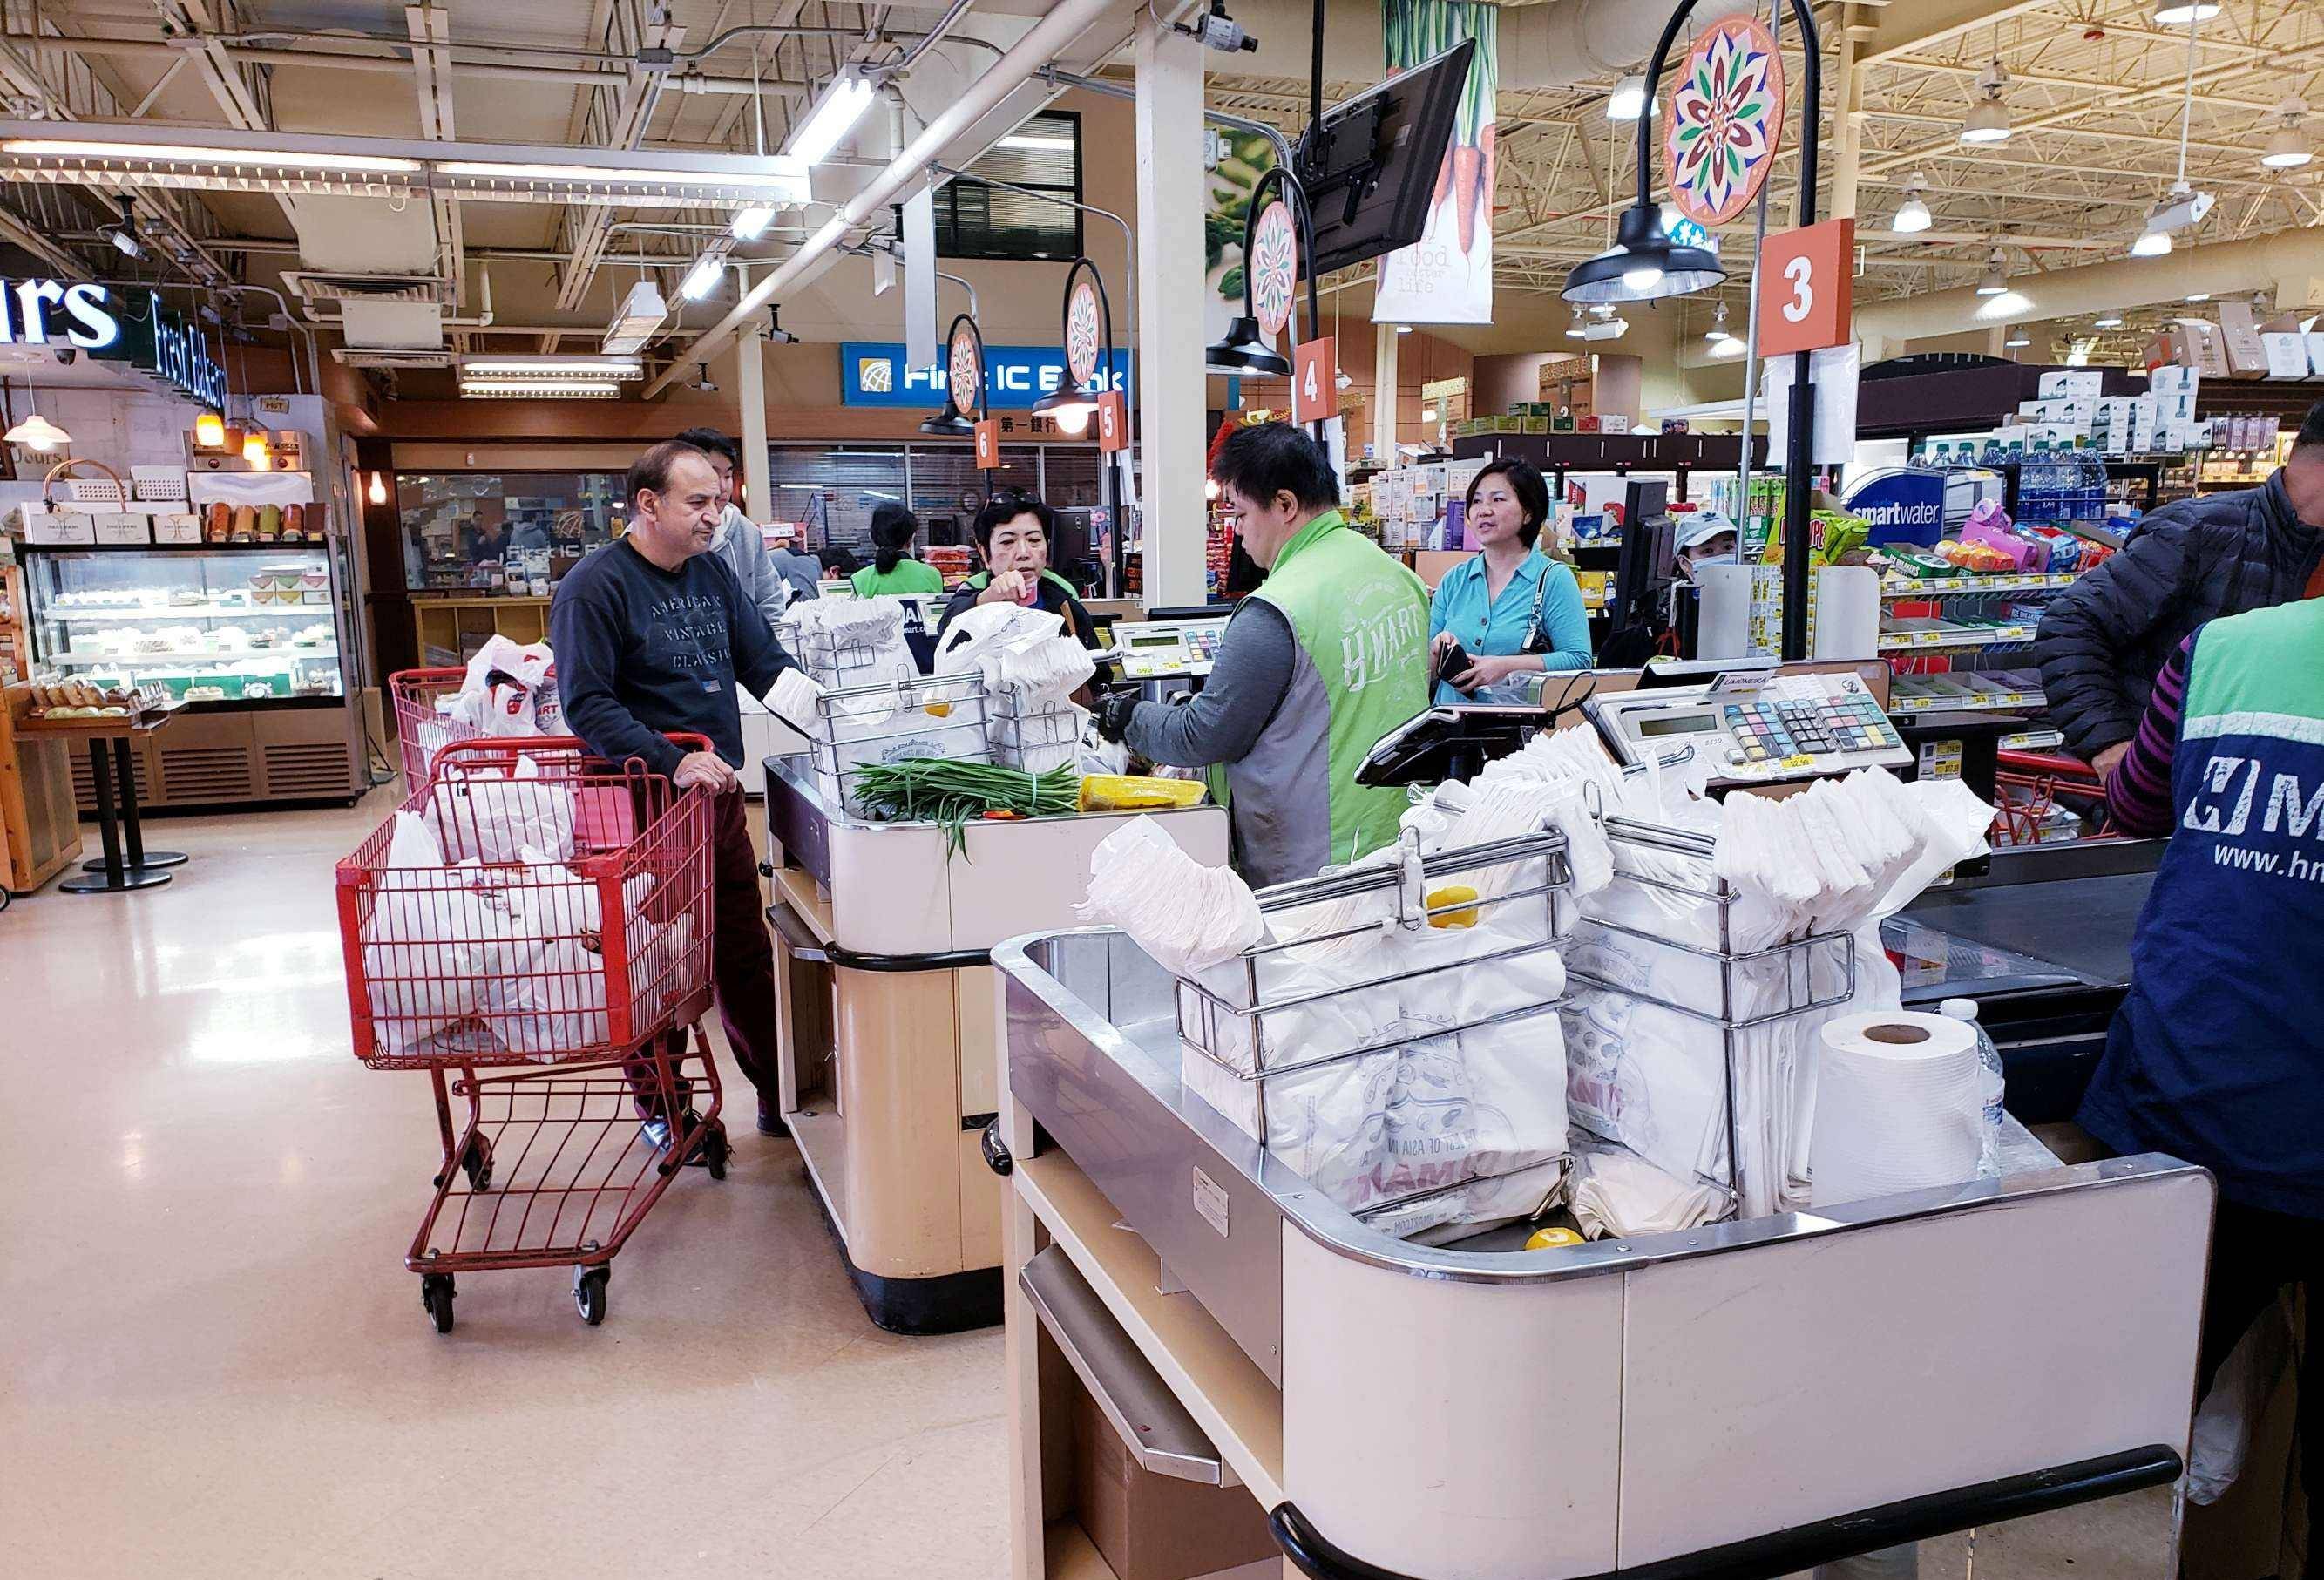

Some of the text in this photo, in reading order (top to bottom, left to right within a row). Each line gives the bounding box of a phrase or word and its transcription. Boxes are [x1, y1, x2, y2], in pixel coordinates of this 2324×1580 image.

[1782, 255, 1814, 322] 3
[997, 364, 1031, 390] IC
[1038, 364, 1123, 391] Bnk
[1304, 360, 1318, 403] 4
[1103, 405, 1113, 437] 5
[979, 431, 988, 458] 6
[1853, 501, 1940, 525] smartwater
